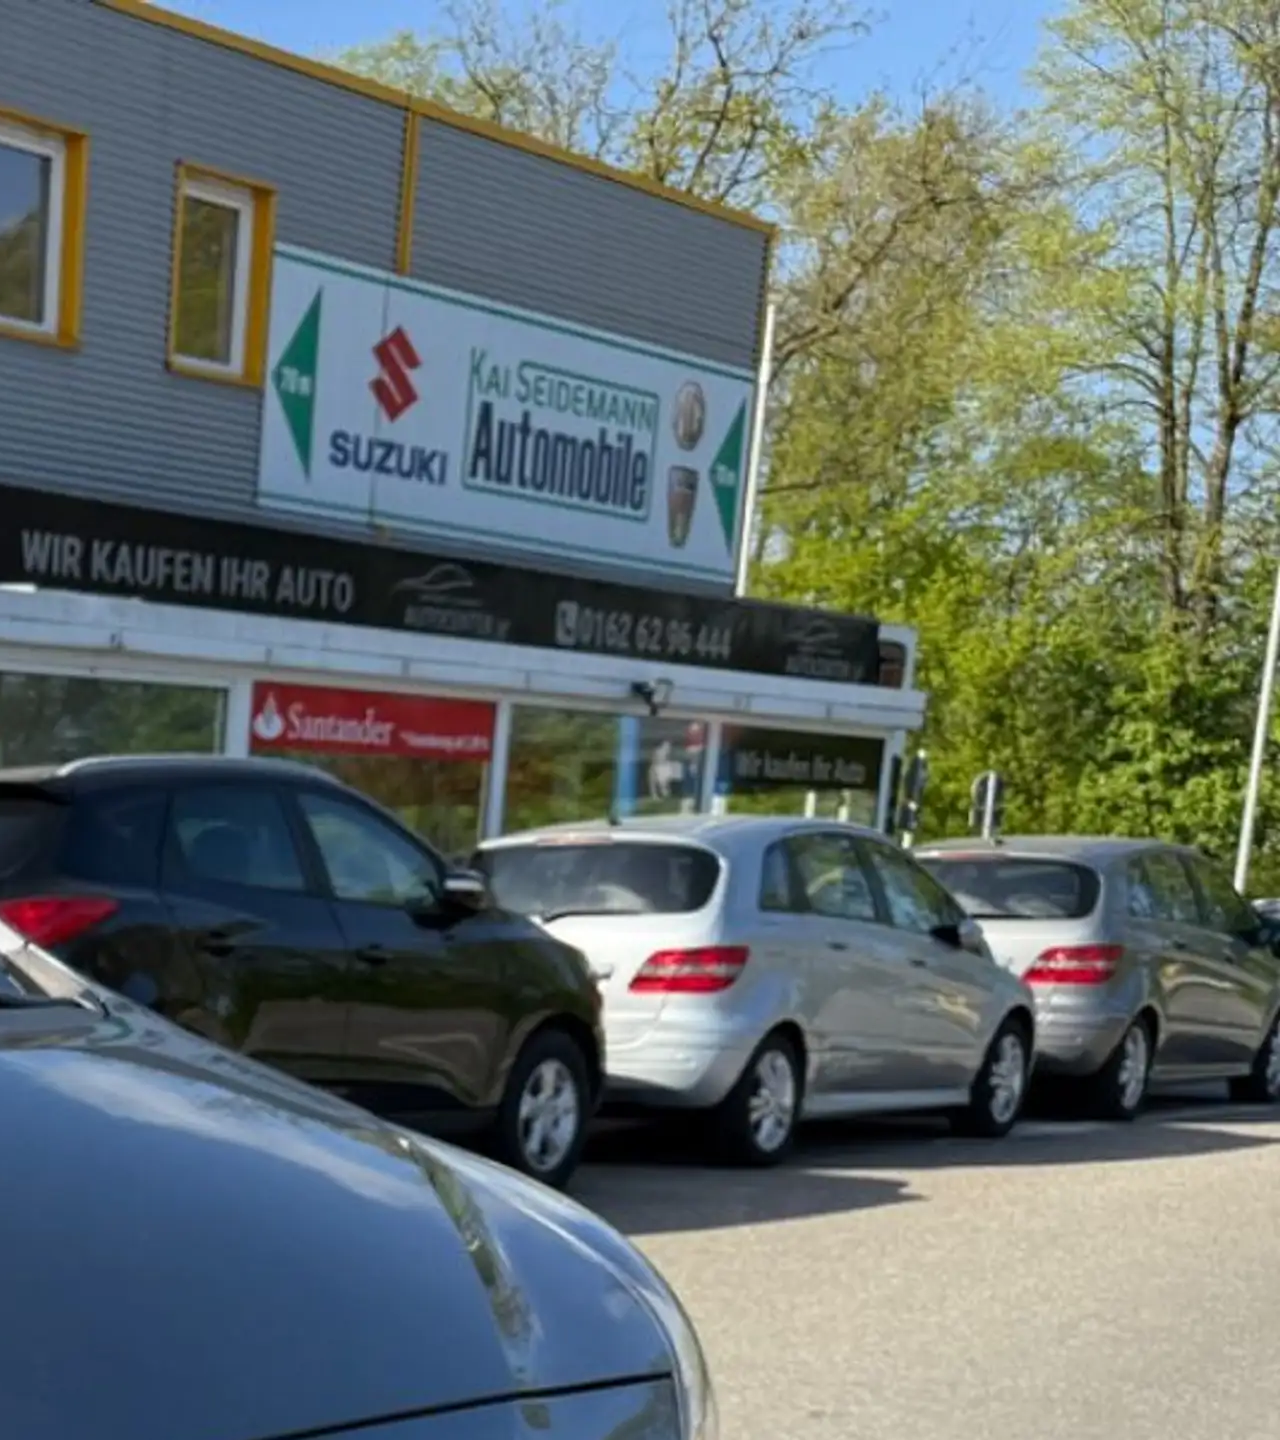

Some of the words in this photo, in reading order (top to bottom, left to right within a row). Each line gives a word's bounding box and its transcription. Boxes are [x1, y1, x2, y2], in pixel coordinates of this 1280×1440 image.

[328, 428, 449, 487] SUZUKI
[469, 399, 649, 512] Automobile
[20, 528, 84, 579] WIR
[91, 538, 215, 596] KAUFEN
[219, 557, 270, 600] IHR
[275, 565, 356, 613] AUTO
[286, 701, 396, 746] Santander
